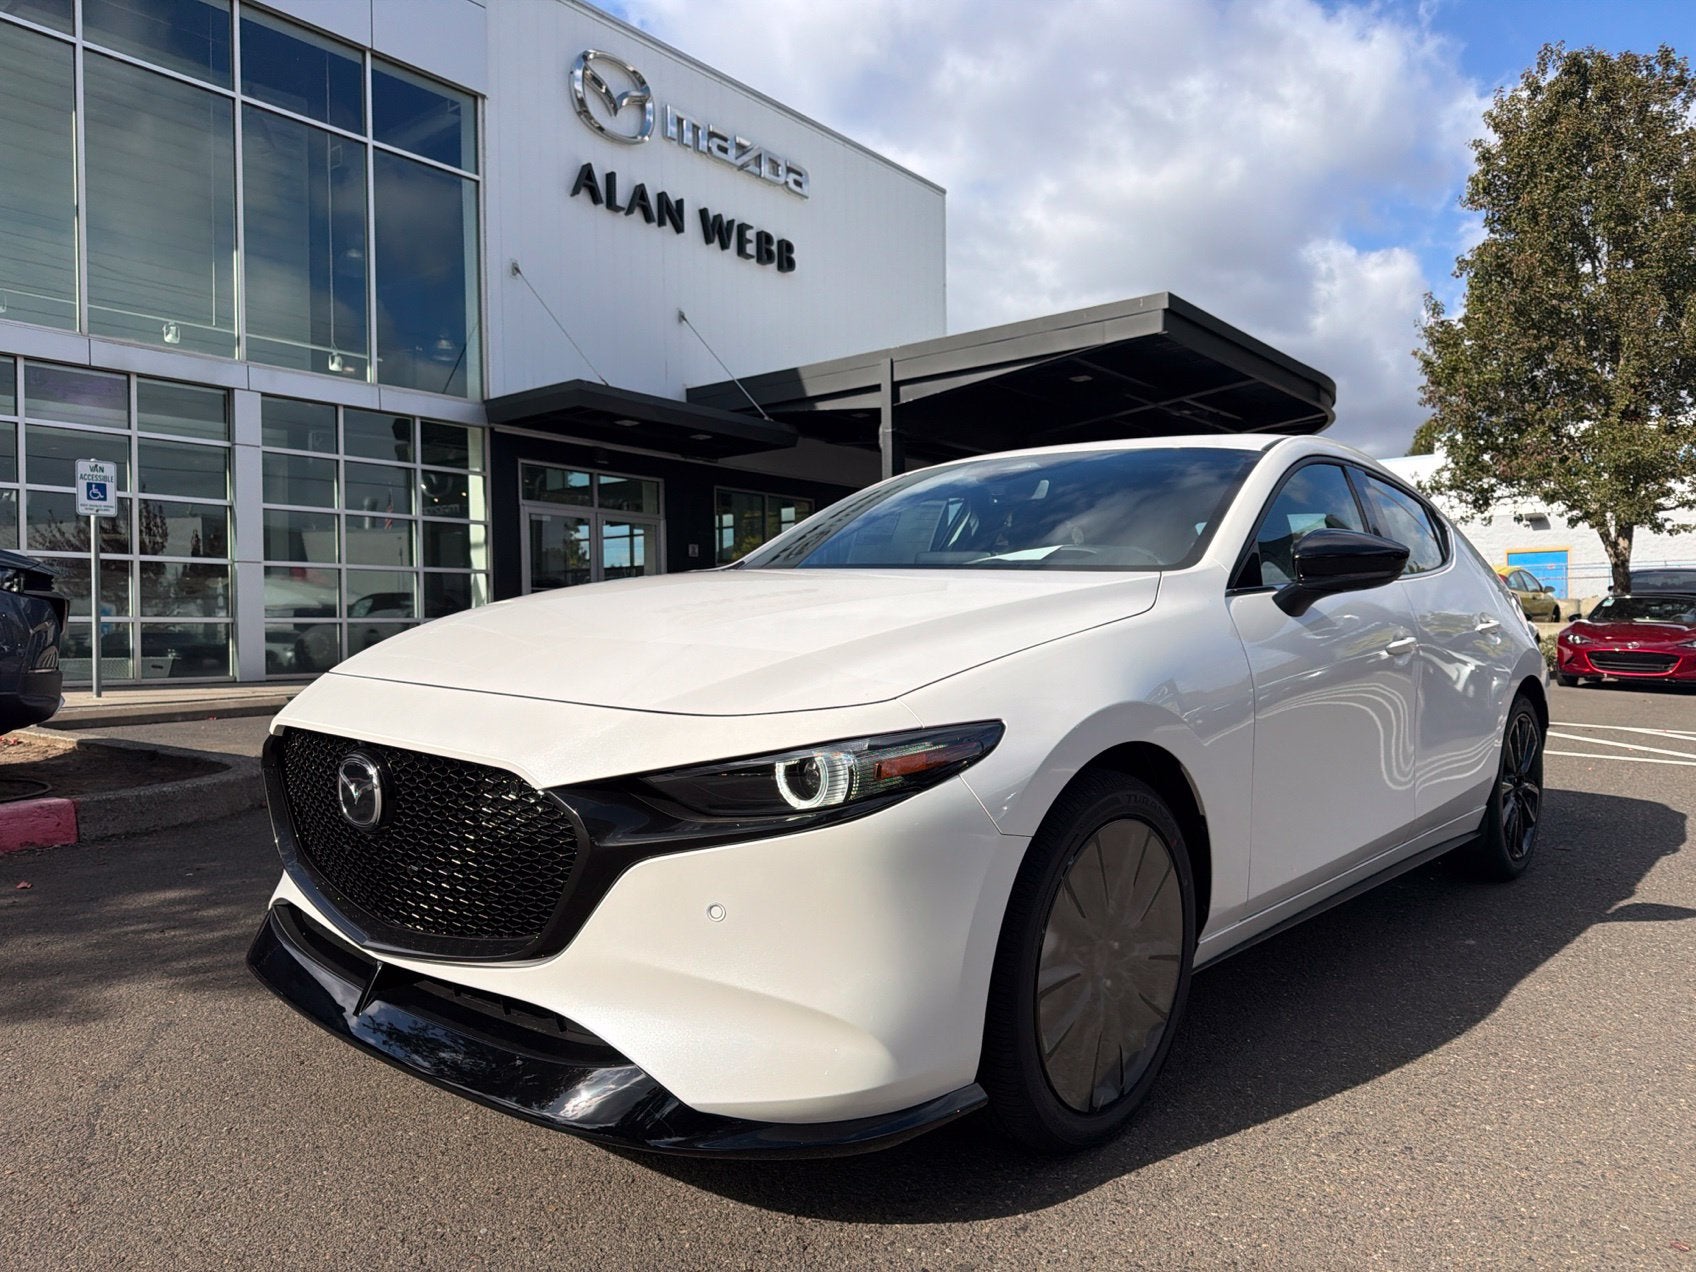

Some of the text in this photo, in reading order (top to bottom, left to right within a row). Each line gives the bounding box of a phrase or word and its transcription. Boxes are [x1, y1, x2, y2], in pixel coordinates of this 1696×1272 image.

[570, 162, 796, 273] ALAN WEBB
[89, 464, 104, 473] VAN
[79, 473, 114, 483] ACCESSIBLE
